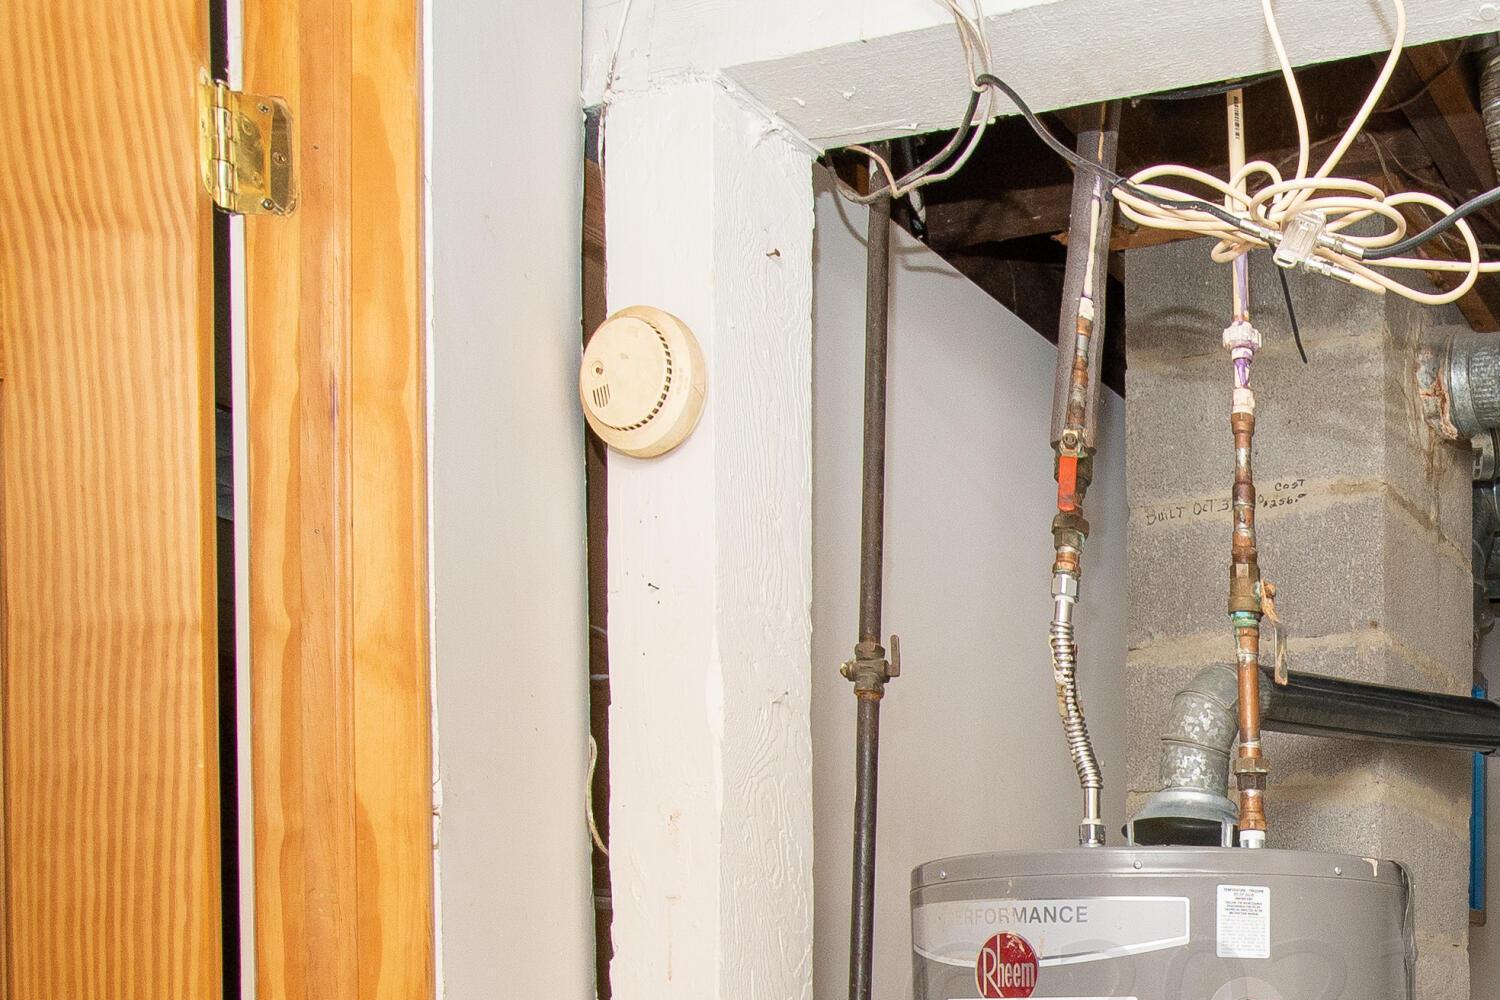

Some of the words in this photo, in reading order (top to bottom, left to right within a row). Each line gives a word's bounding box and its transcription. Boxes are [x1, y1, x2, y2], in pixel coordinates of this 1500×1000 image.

[1274, 479, 1305, 491] COST
[948, 905, 1088, 926] ERFORMANCE
[982, 933, 1035, 998] Rheem
